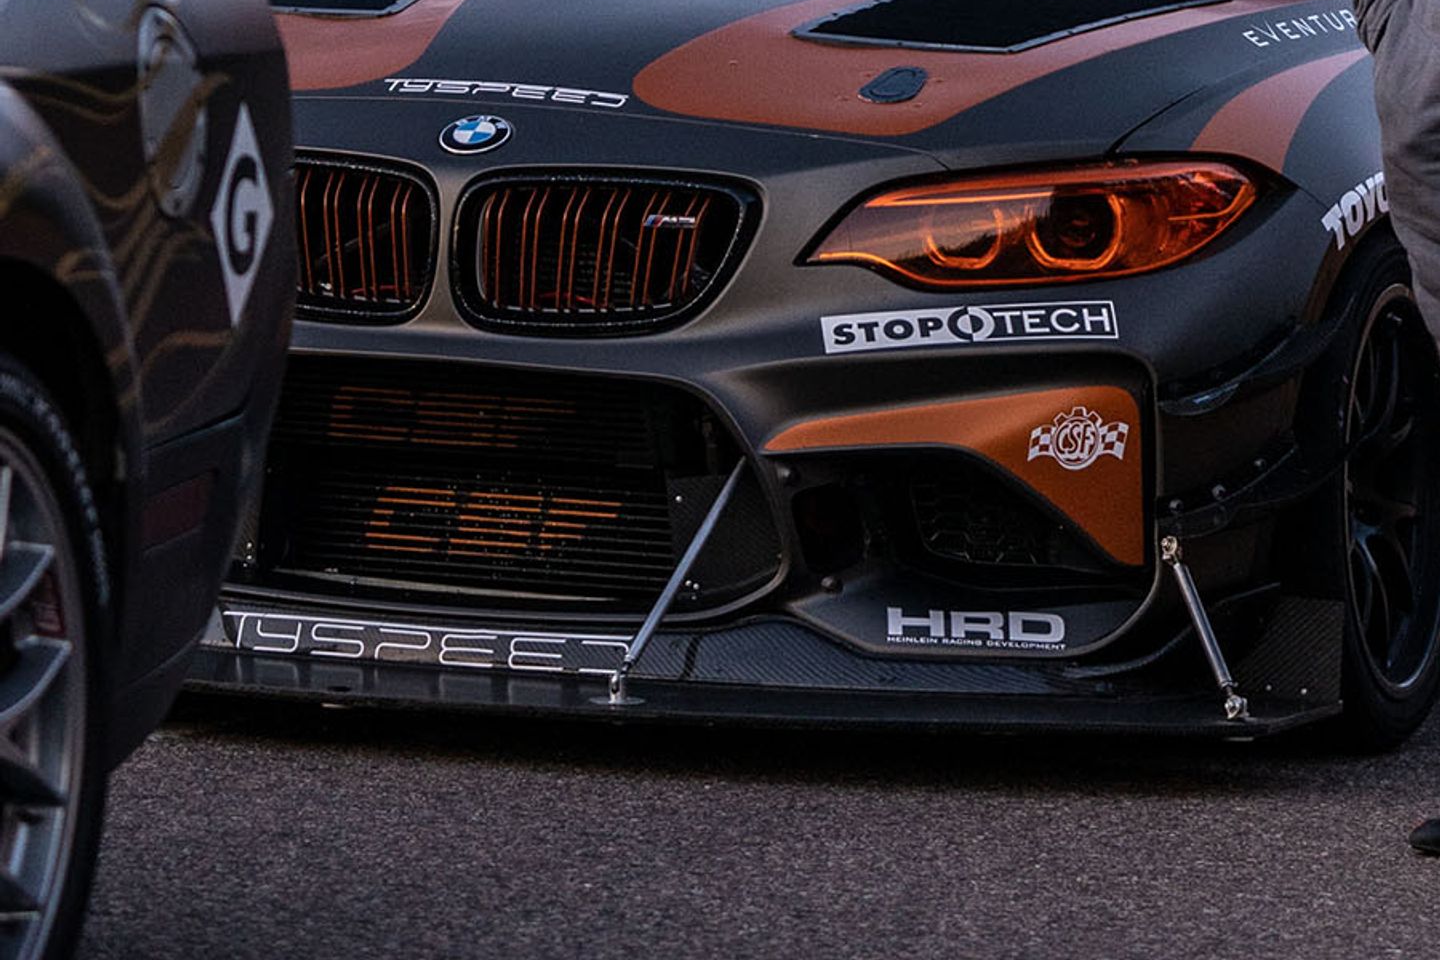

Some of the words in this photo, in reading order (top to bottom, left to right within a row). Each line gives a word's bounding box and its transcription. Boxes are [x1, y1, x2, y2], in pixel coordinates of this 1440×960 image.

[225, 153, 258, 275] G
[886, 607, 1066, 643] HRD
[886, 636, 938, 645] HEINLEIN
[942, 638, 983, 647] RACING
[986, 640, 1067, 651] DEVELOPMENT
